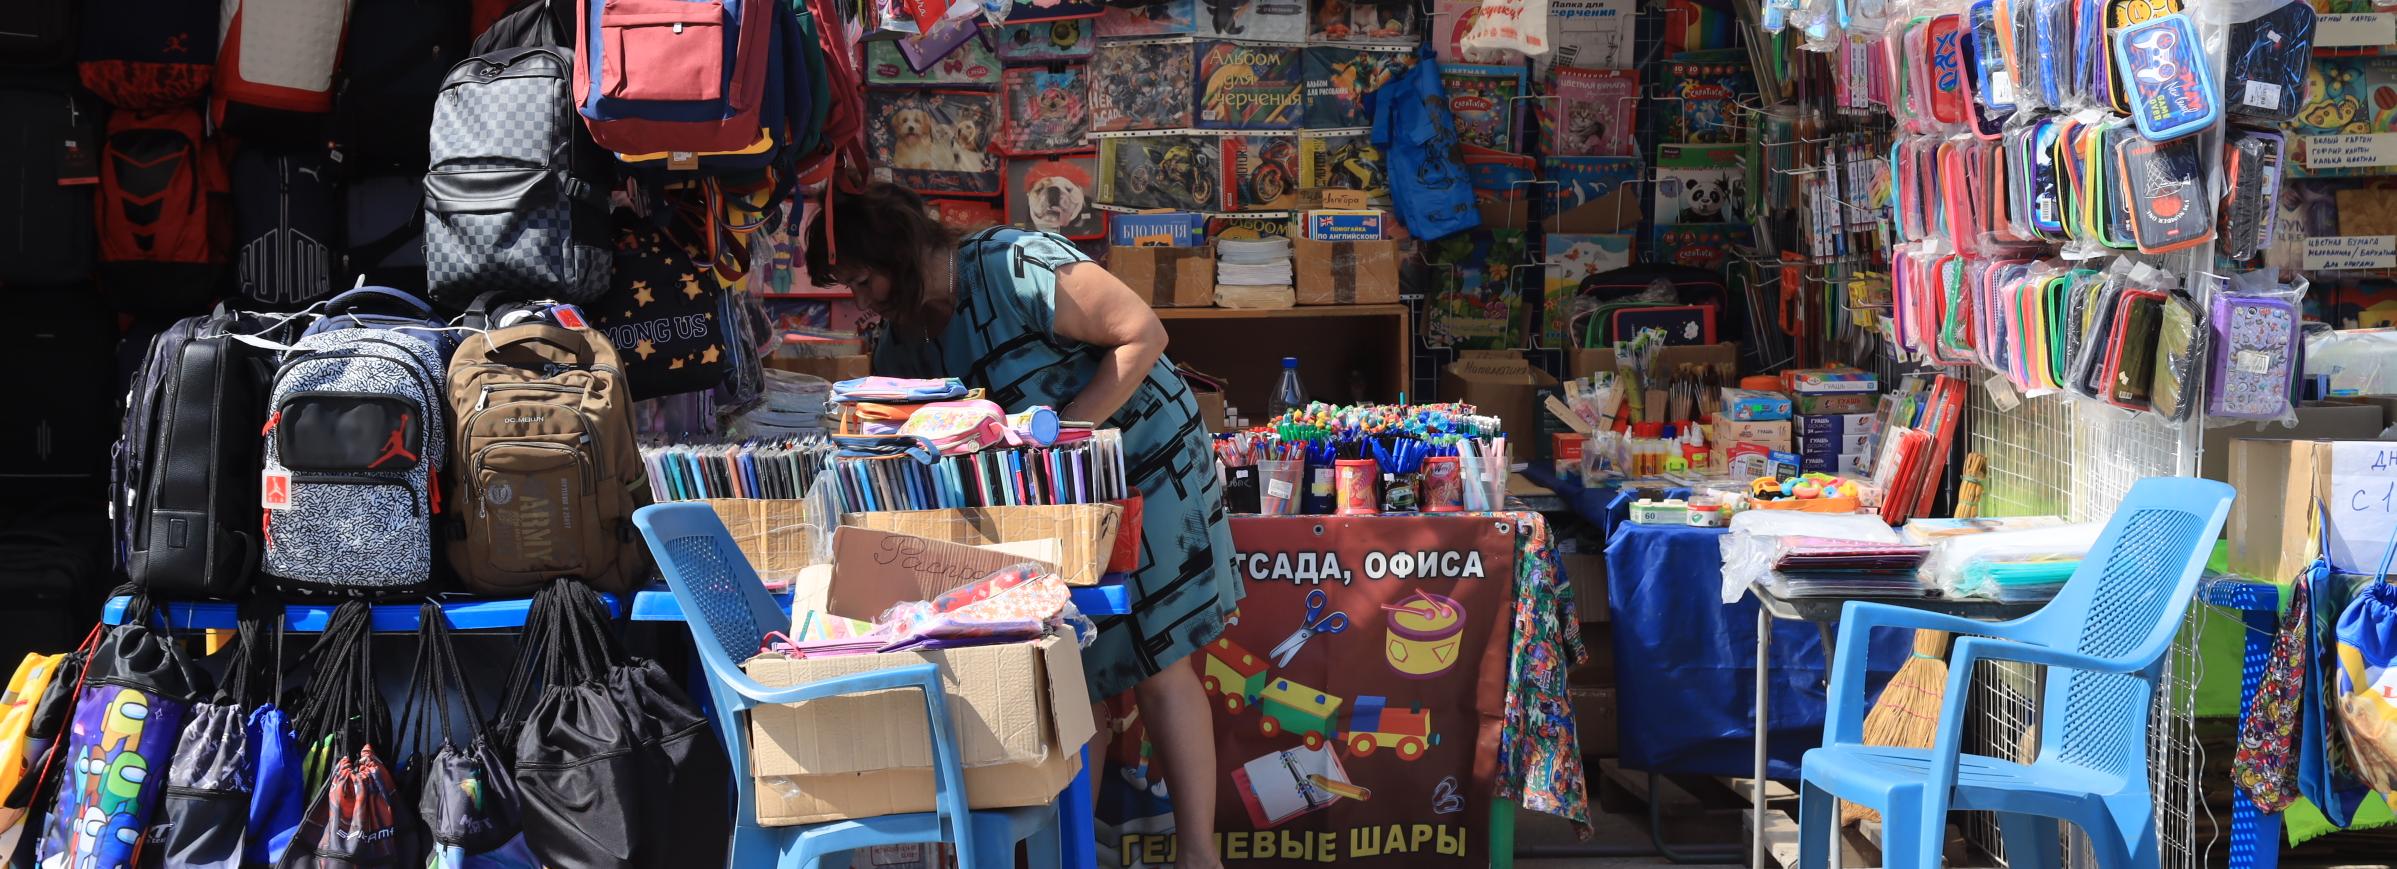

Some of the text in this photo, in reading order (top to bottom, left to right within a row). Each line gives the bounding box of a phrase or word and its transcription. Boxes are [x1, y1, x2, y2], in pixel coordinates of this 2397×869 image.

[1210, 49, 1281, 65] Альбом
[1224, 73, 1255, 89] для
[1215, 92, 1302, 109] черчения
[2157, 94, 2171, 119] GAME
[2347, 238, 2379, 246] БУМАГА
[601, 313, 708, 351] MONG US
[1644, 512, 1656, 520] 60
[519, 495, 553, 561] ARMY
[1235, 549, 1485, 586] ТСАДА, ОФИСА
[1120, 824, 1467, 866] ГЕЕВЫЕ ШАРЫ
